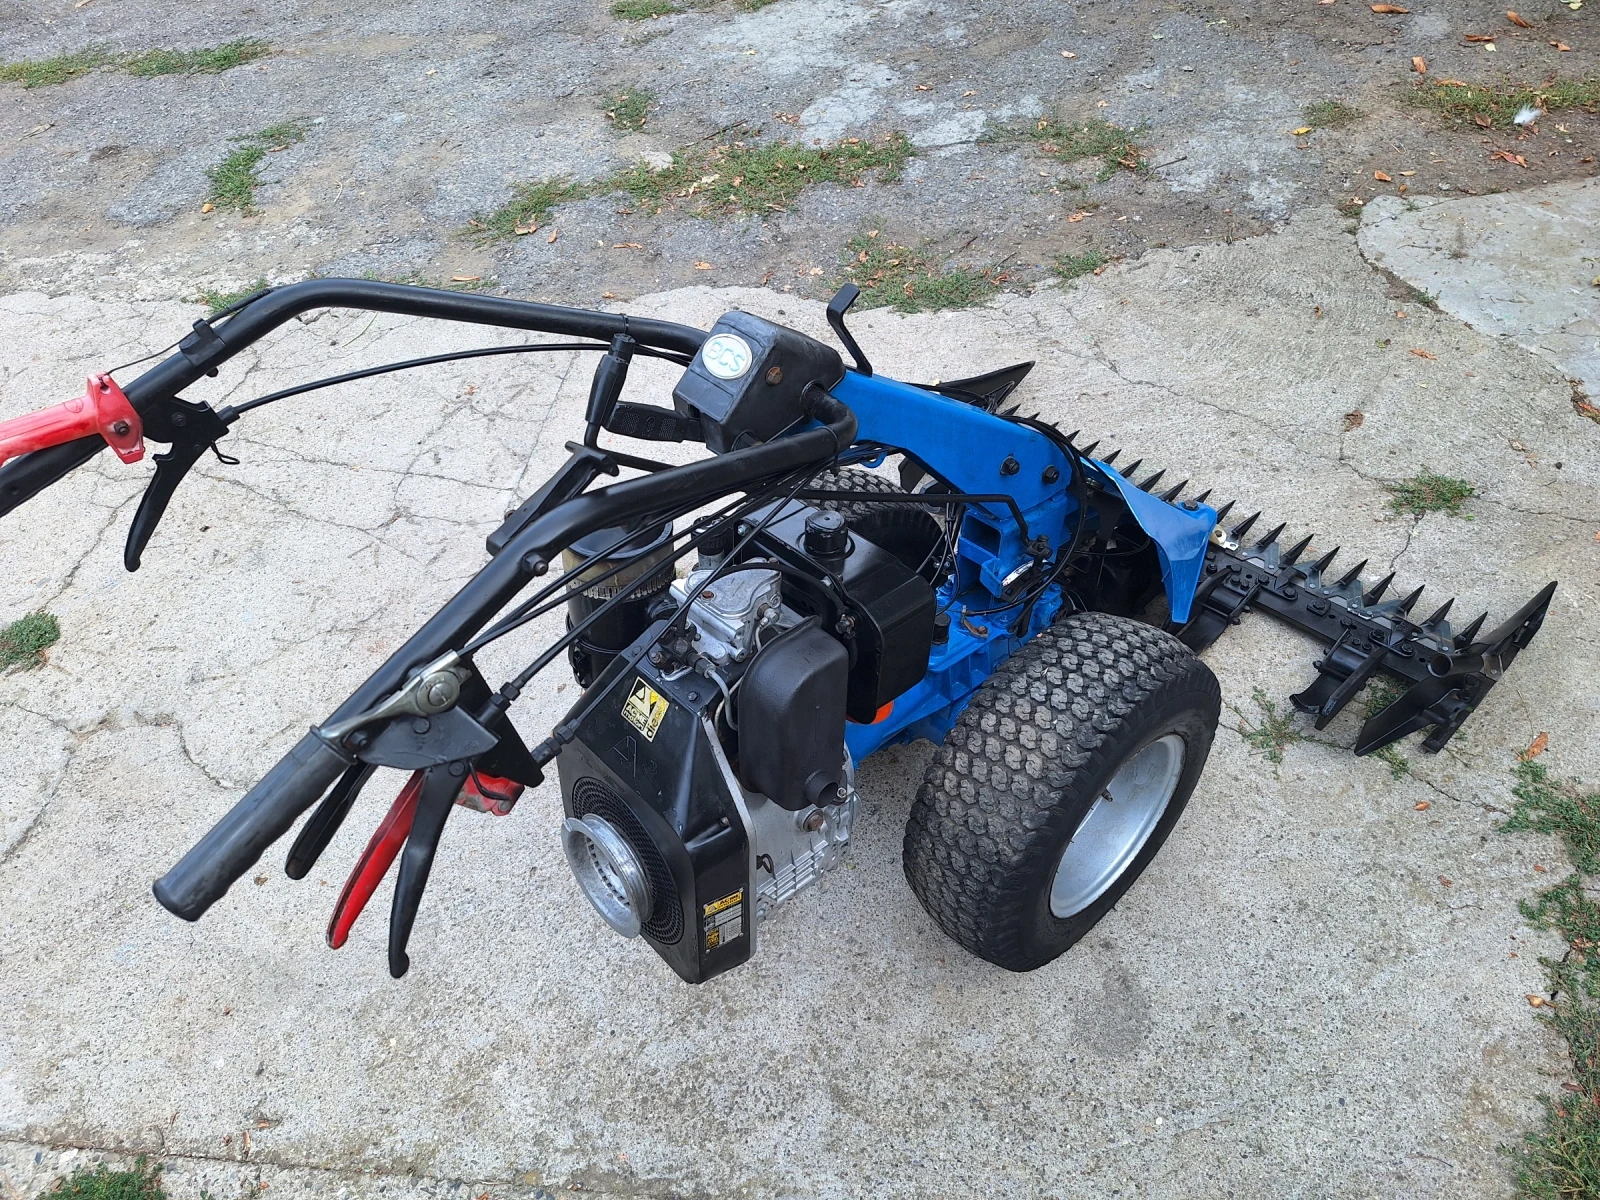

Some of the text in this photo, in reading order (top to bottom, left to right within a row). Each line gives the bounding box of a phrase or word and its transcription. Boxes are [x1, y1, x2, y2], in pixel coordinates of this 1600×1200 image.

[706, 340, 745, 372] BCS
[625, 704, 647, 724] ACME
[646, 702, 666, 738] dies
